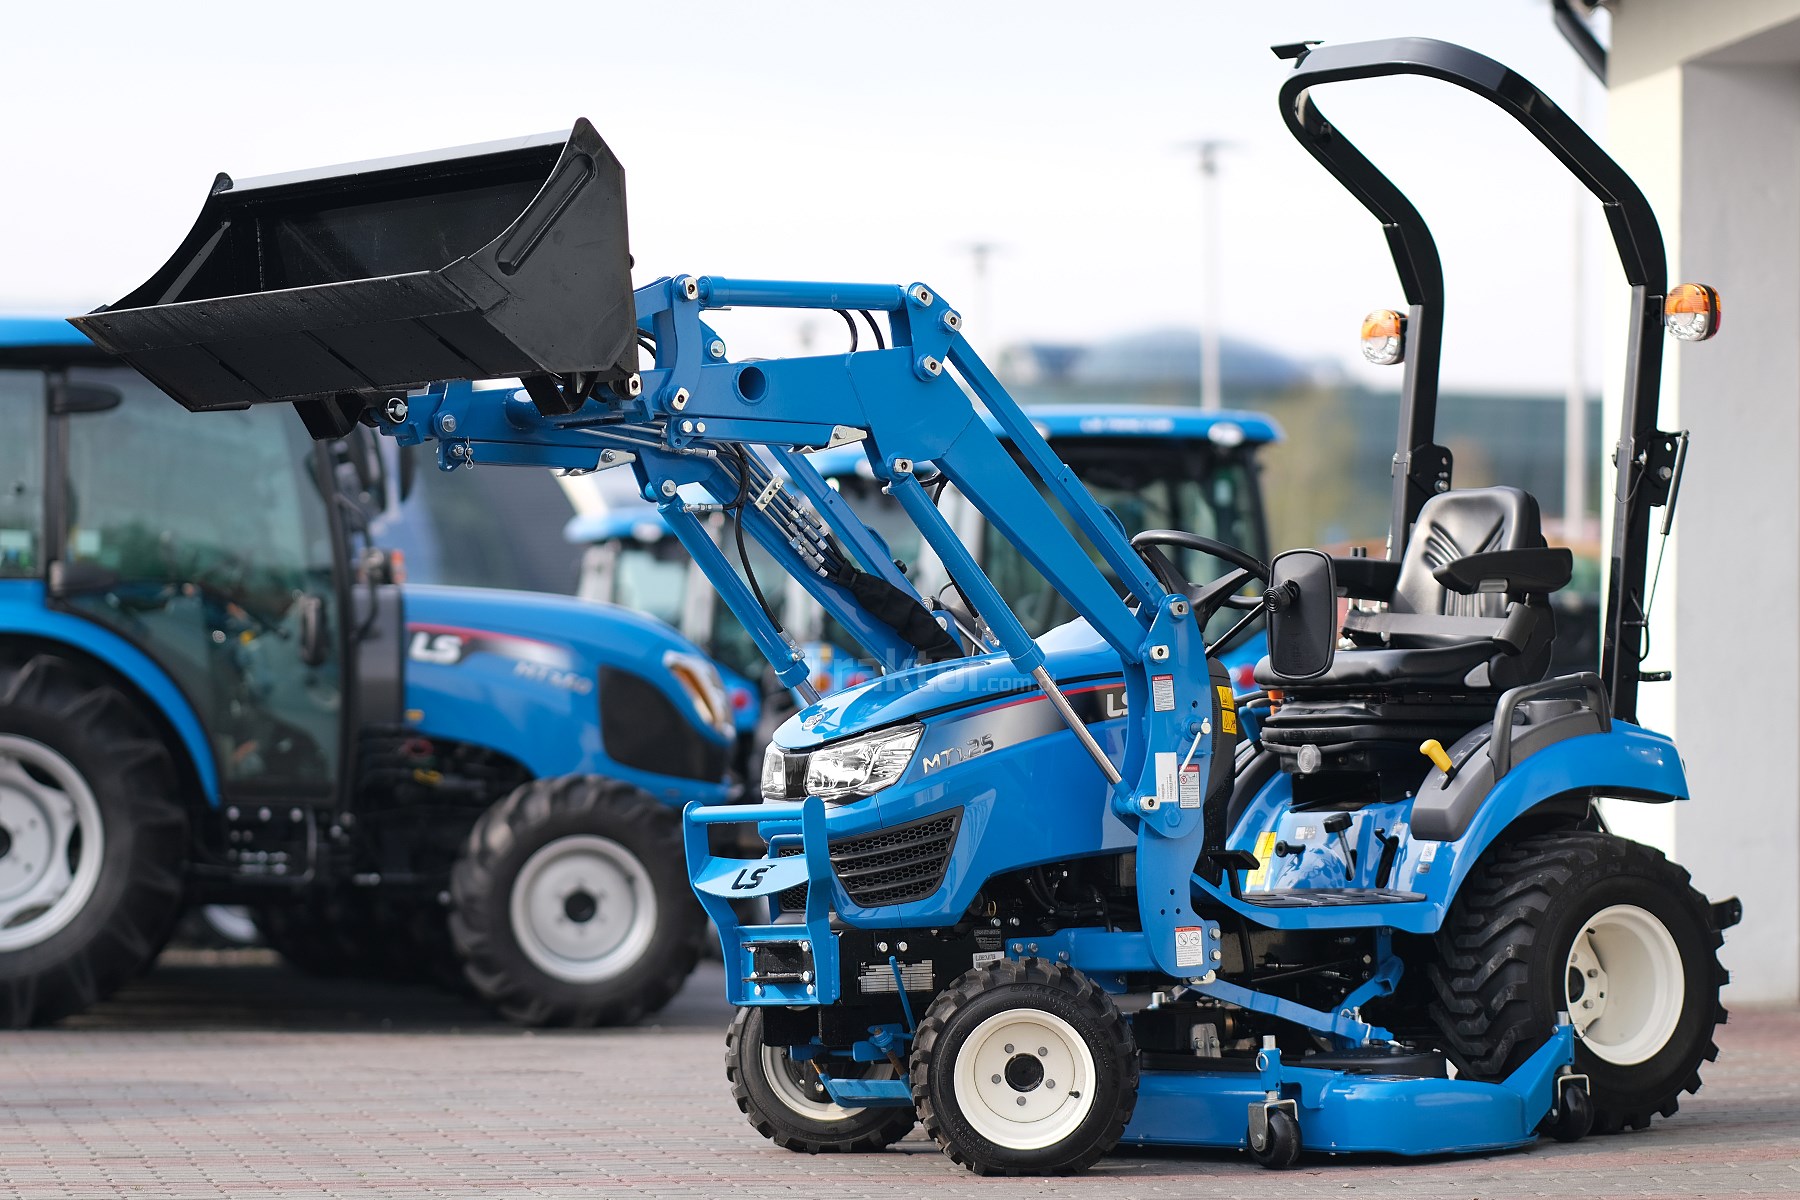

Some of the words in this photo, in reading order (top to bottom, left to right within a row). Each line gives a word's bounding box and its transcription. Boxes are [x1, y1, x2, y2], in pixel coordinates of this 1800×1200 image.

[409, 631, 463, 665] LS
[922, 733, 995, 774] MT1.25
[731, 865, 772, 890] LS
